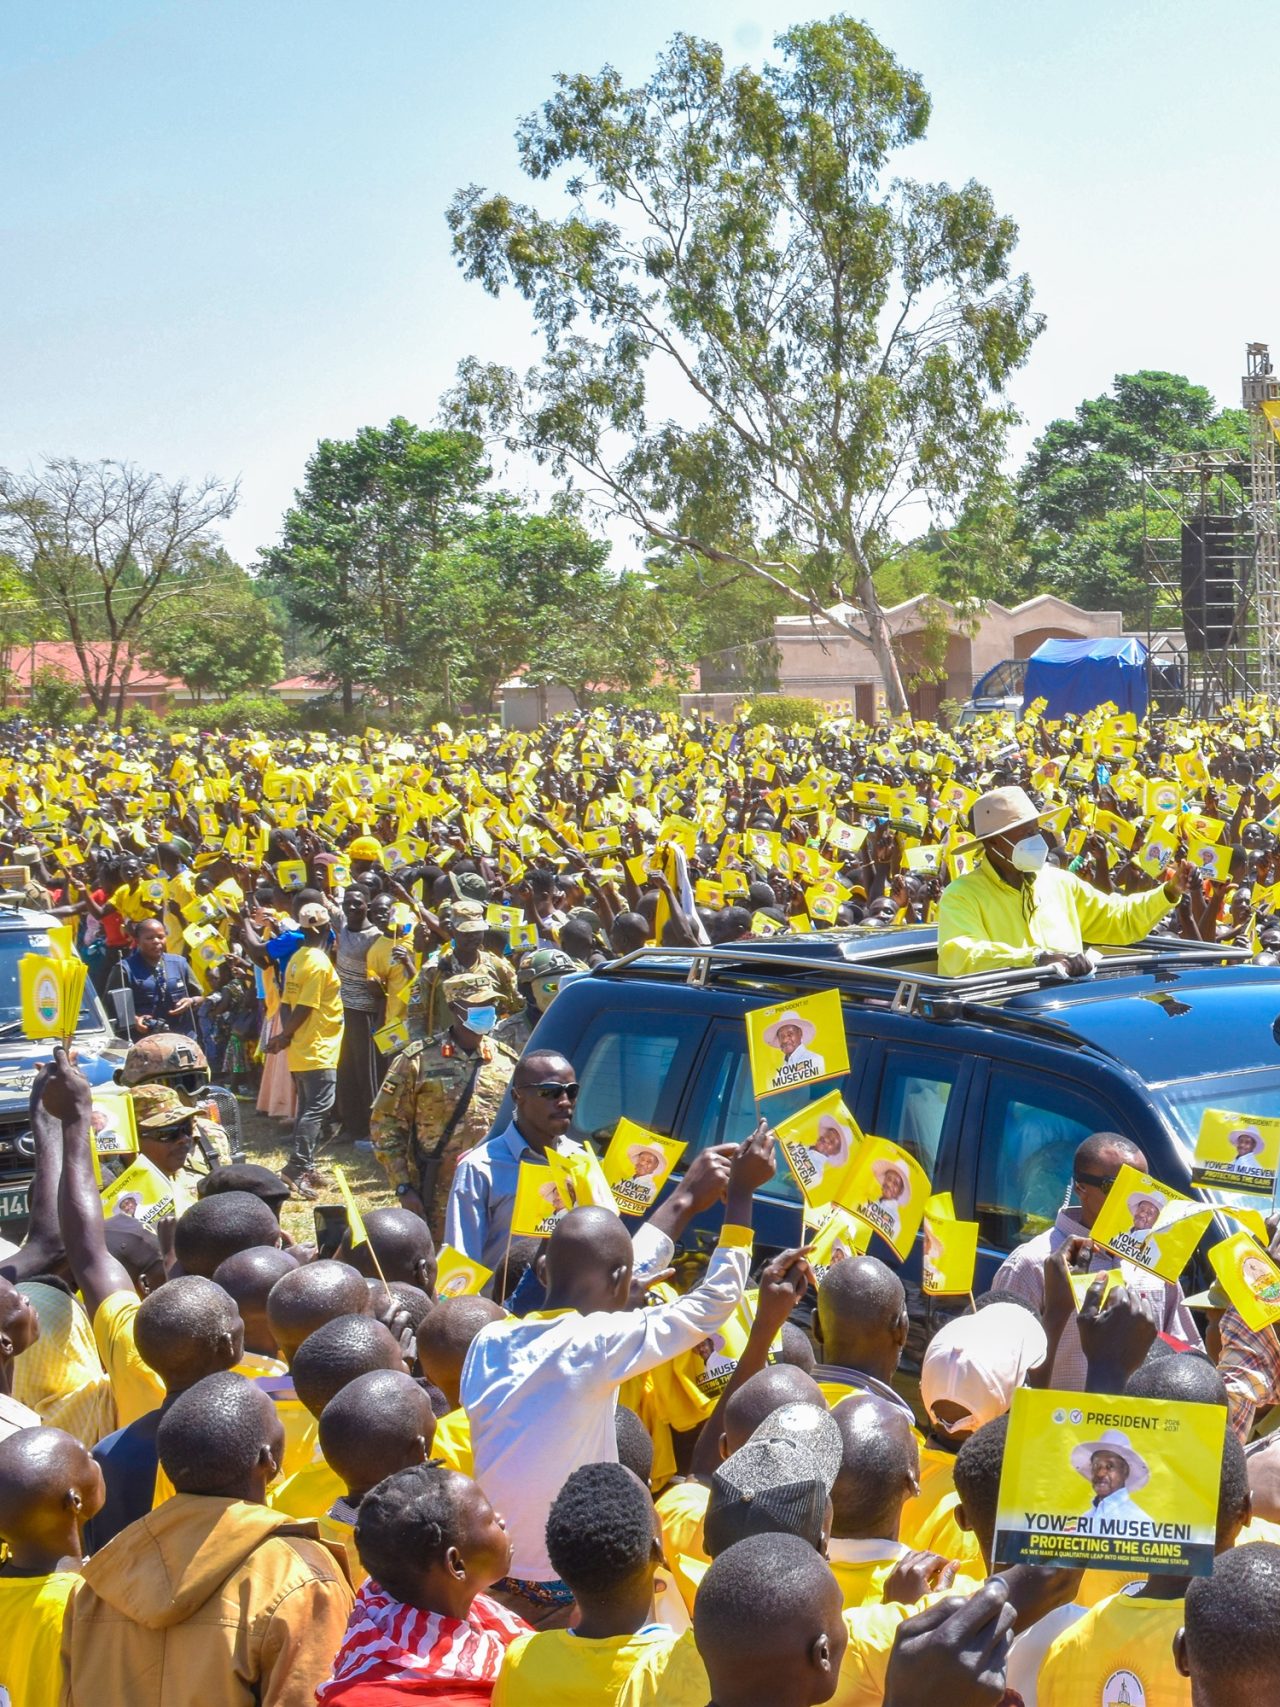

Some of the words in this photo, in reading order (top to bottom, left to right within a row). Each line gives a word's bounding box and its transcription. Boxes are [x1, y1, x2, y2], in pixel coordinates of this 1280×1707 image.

[772, 1066, 819, 1088] MUSEVENI
[776, 1059, 812, 1076] YOWERI
[786, 1141, 812, 1186] MUSEVENI
[796, 1142, 817, 1176] YOWERI
[1204, 1160, 1234, 1172] YOWERI
[108, 1176, 132, 1200] PRESIDENT
[620, 1178, 650, 1194] YOWERI
[1150, 1182, 1178, 1200] PRESIDENT
[856, 1204, 894, 1239] MUSEVENI
[867, 1198, 894, 1226] YOWERI
[1108, 1238, 1151, 1266] MUSEVENI
[1086, 1412, 1159, 1430] PRESIDENT
[1025, 1512, 1094, 1533] YOWERI
[1100, 1518, 1190, 1540] MUSEVENI
[1030, 1534, 1109, 1552] PROTECTING
[1113, 1541, 1139, 1554] THE
[1142, 1543, 1181, 1557] GAINS
